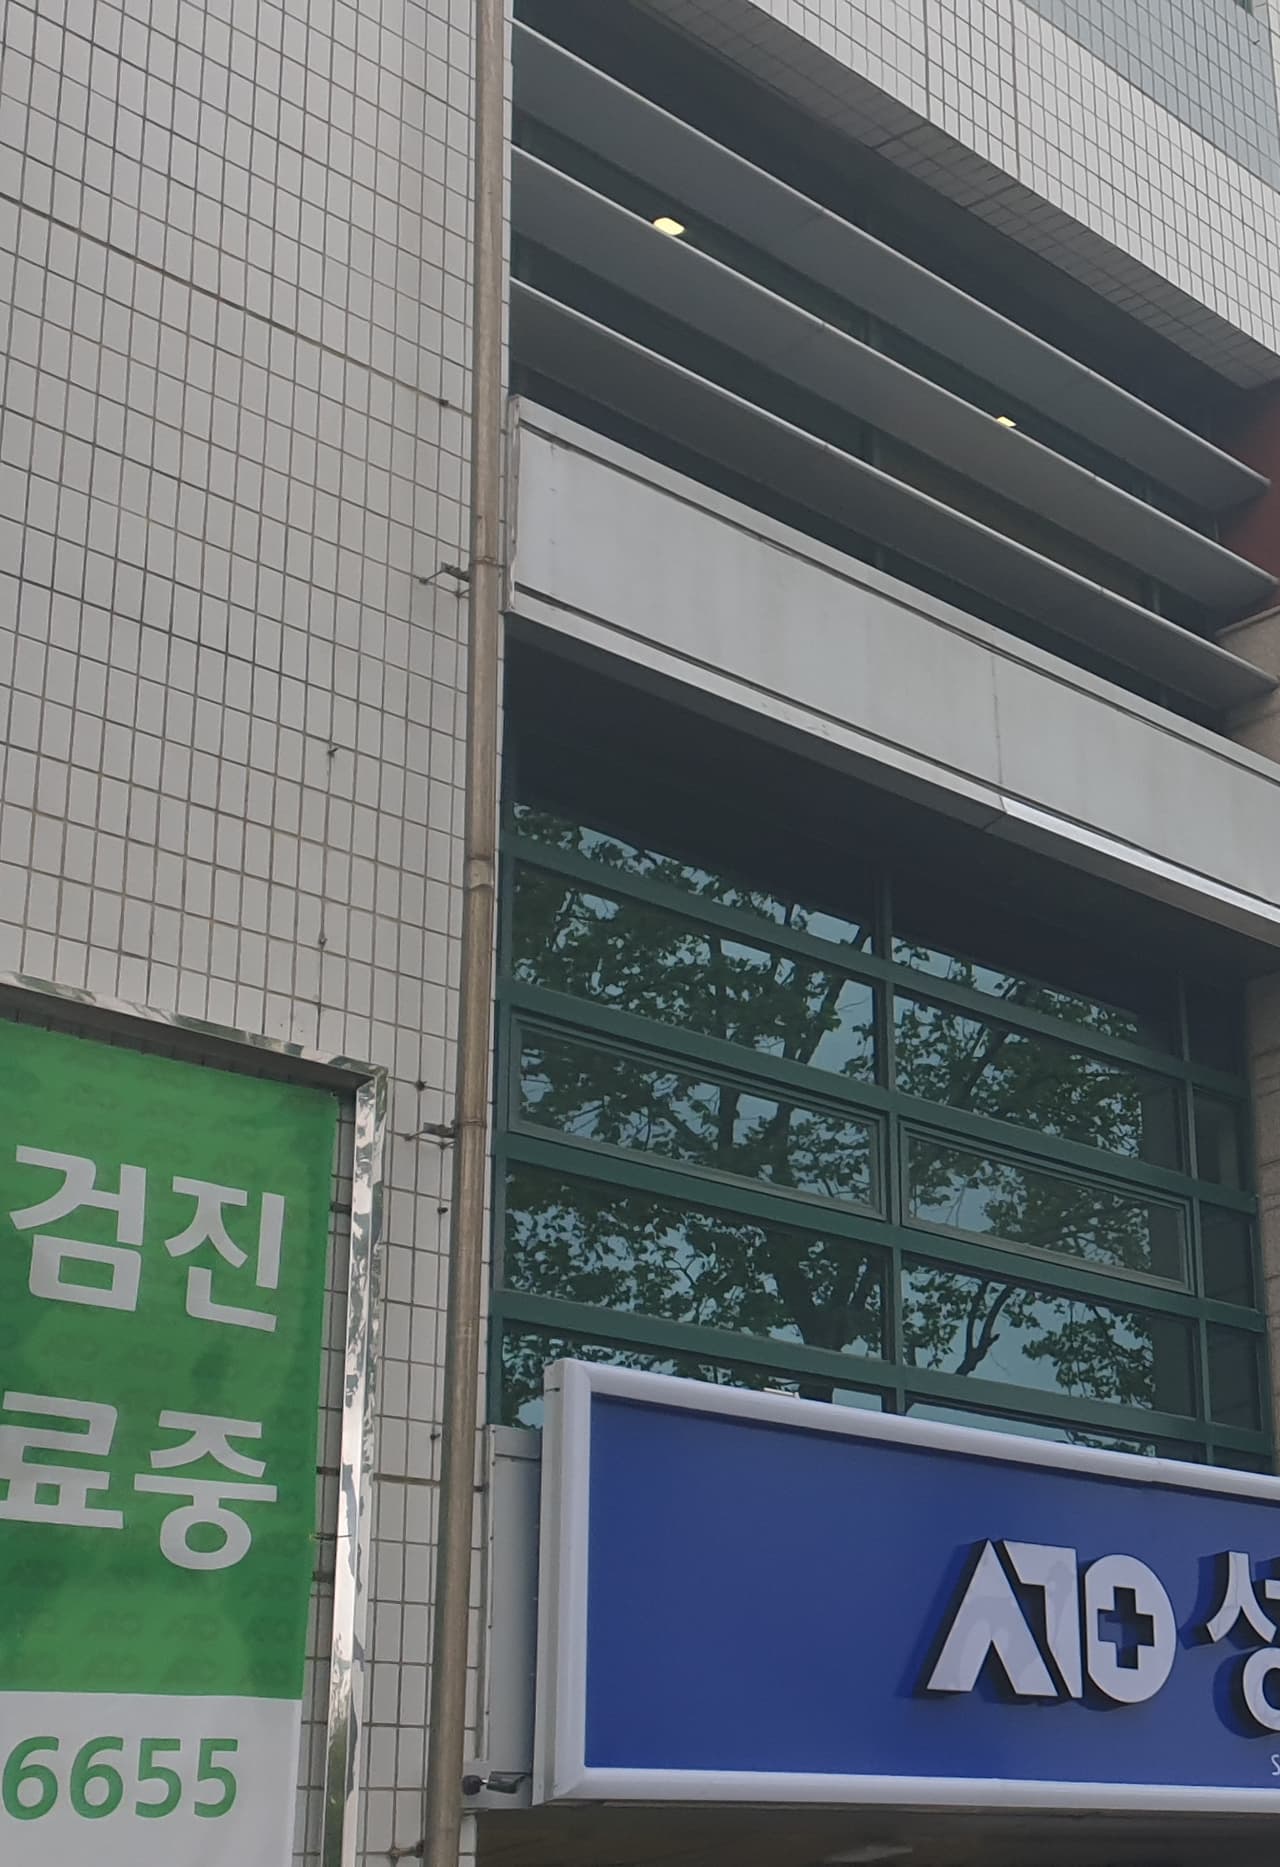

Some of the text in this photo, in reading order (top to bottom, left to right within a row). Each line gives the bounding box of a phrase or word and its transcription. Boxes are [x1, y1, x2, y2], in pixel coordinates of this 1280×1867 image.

[9, 1144, 286, 1333] 검진
[0, 1391, 278, 1571] 료중
[2, 1736, 238, 1819] 6655
